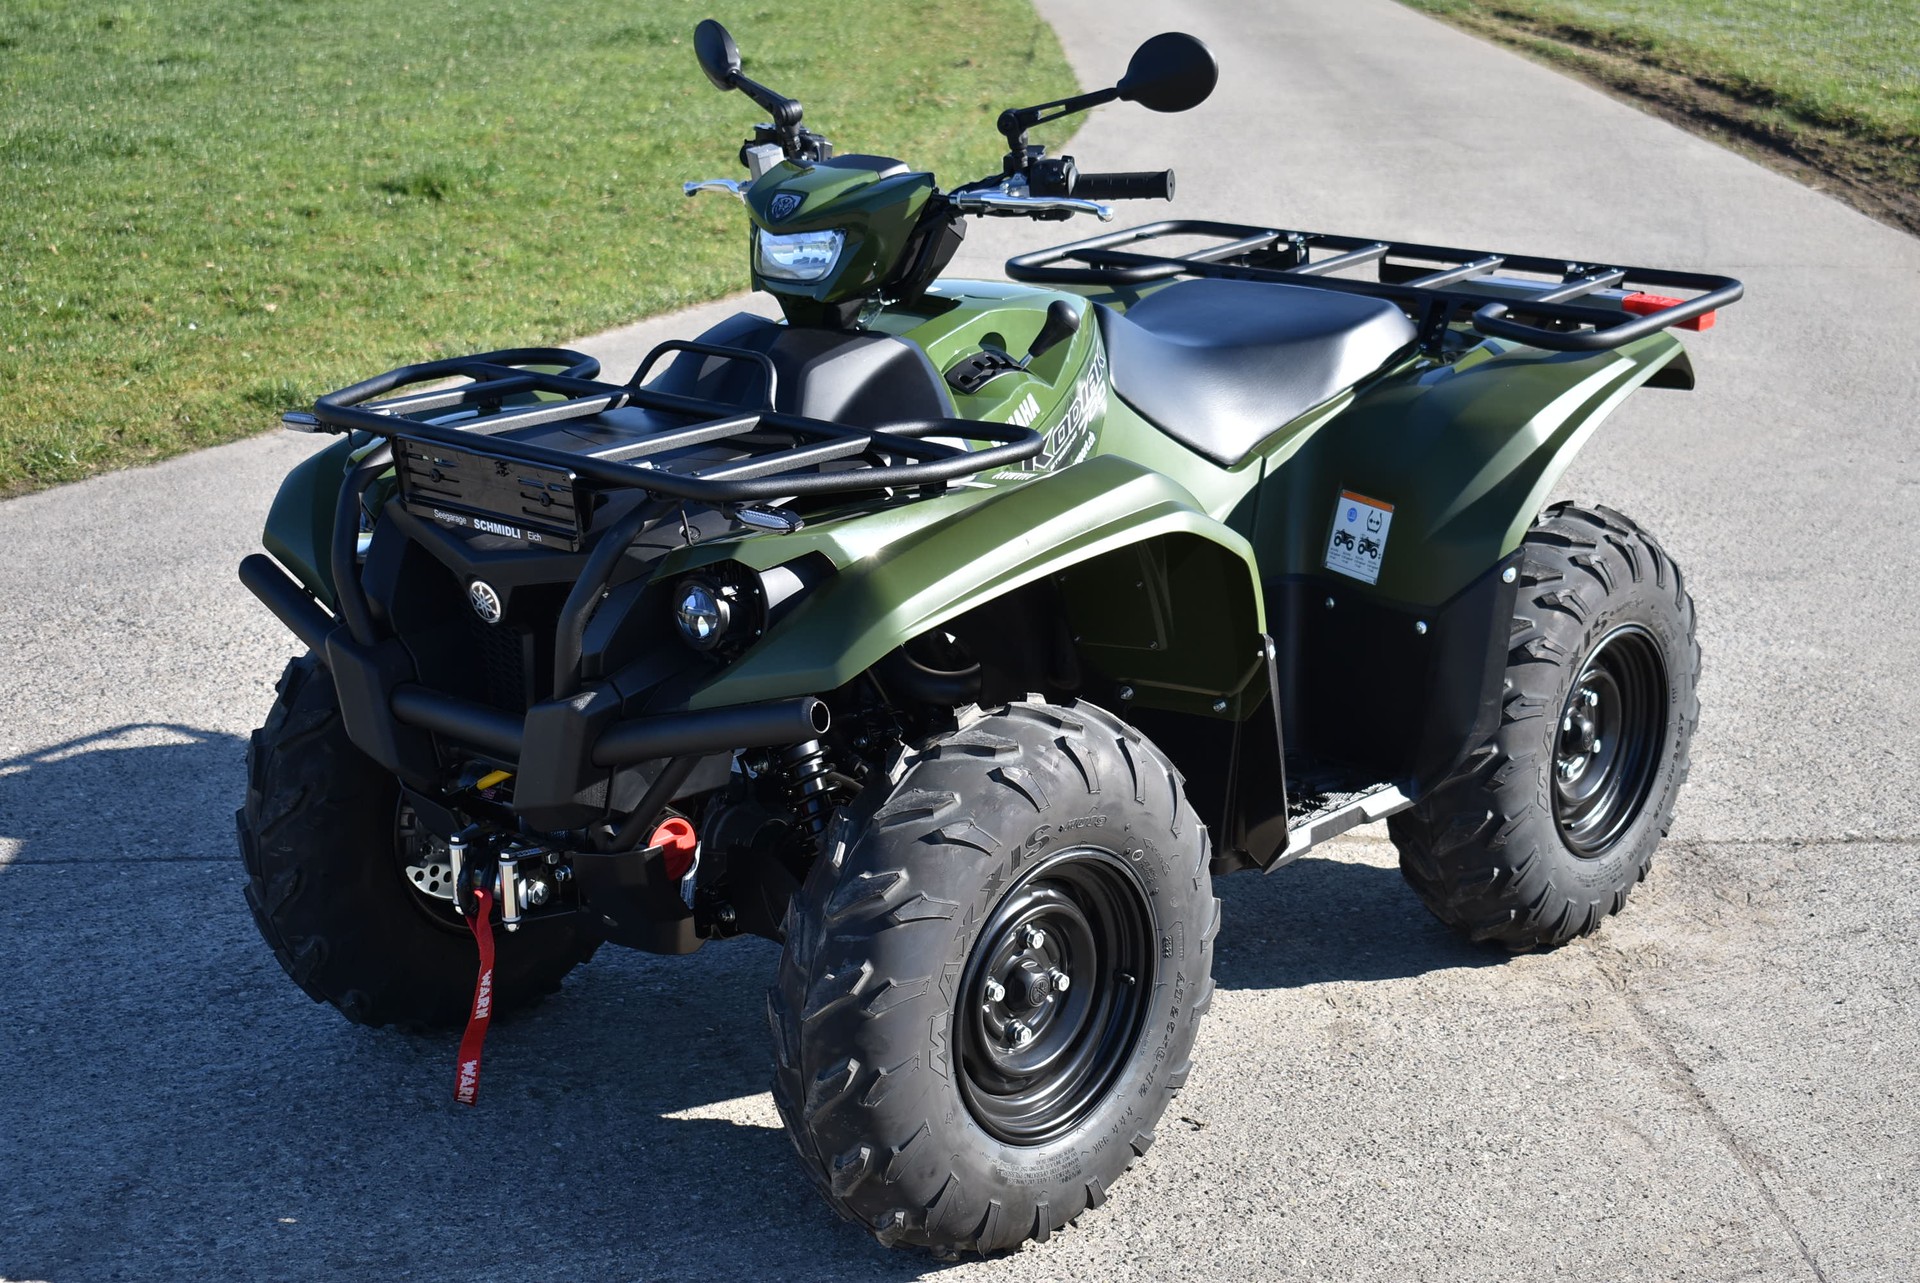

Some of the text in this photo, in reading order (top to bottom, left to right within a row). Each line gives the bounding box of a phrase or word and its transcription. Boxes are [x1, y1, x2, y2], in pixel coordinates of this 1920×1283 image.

[433, 508, 542, 542] Seegarage SCHMIDLI Eich
[928, 823, 1052, 1080] MAXXIS
[474, 968, 493, 1020] WARN
[457, 1059, 478, 1103] WARN
